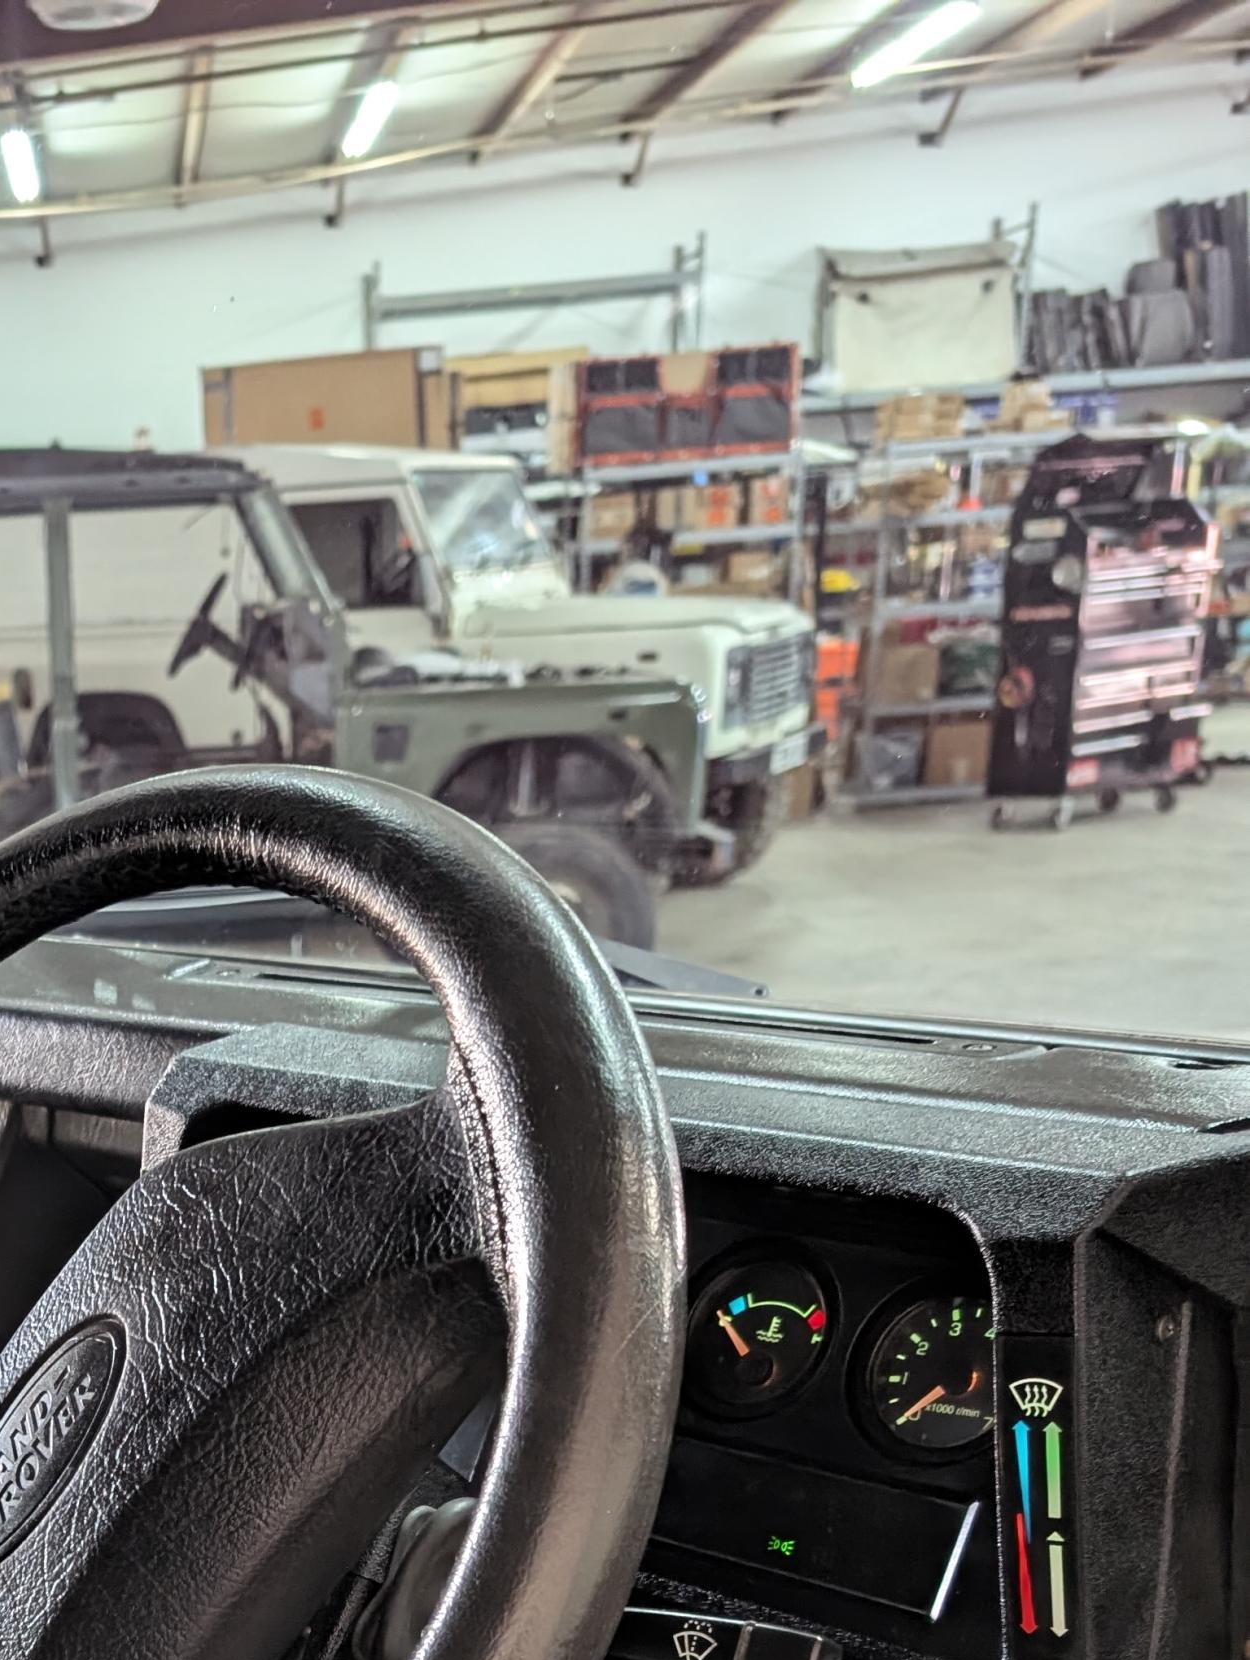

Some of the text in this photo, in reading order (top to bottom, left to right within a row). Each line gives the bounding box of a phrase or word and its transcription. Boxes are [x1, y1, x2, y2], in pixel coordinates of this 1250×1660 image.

[949, 1324, 962, 1337] 3
[984, 1328, 998, 1340] 4
[916, 1342, 930, 1356] 2
